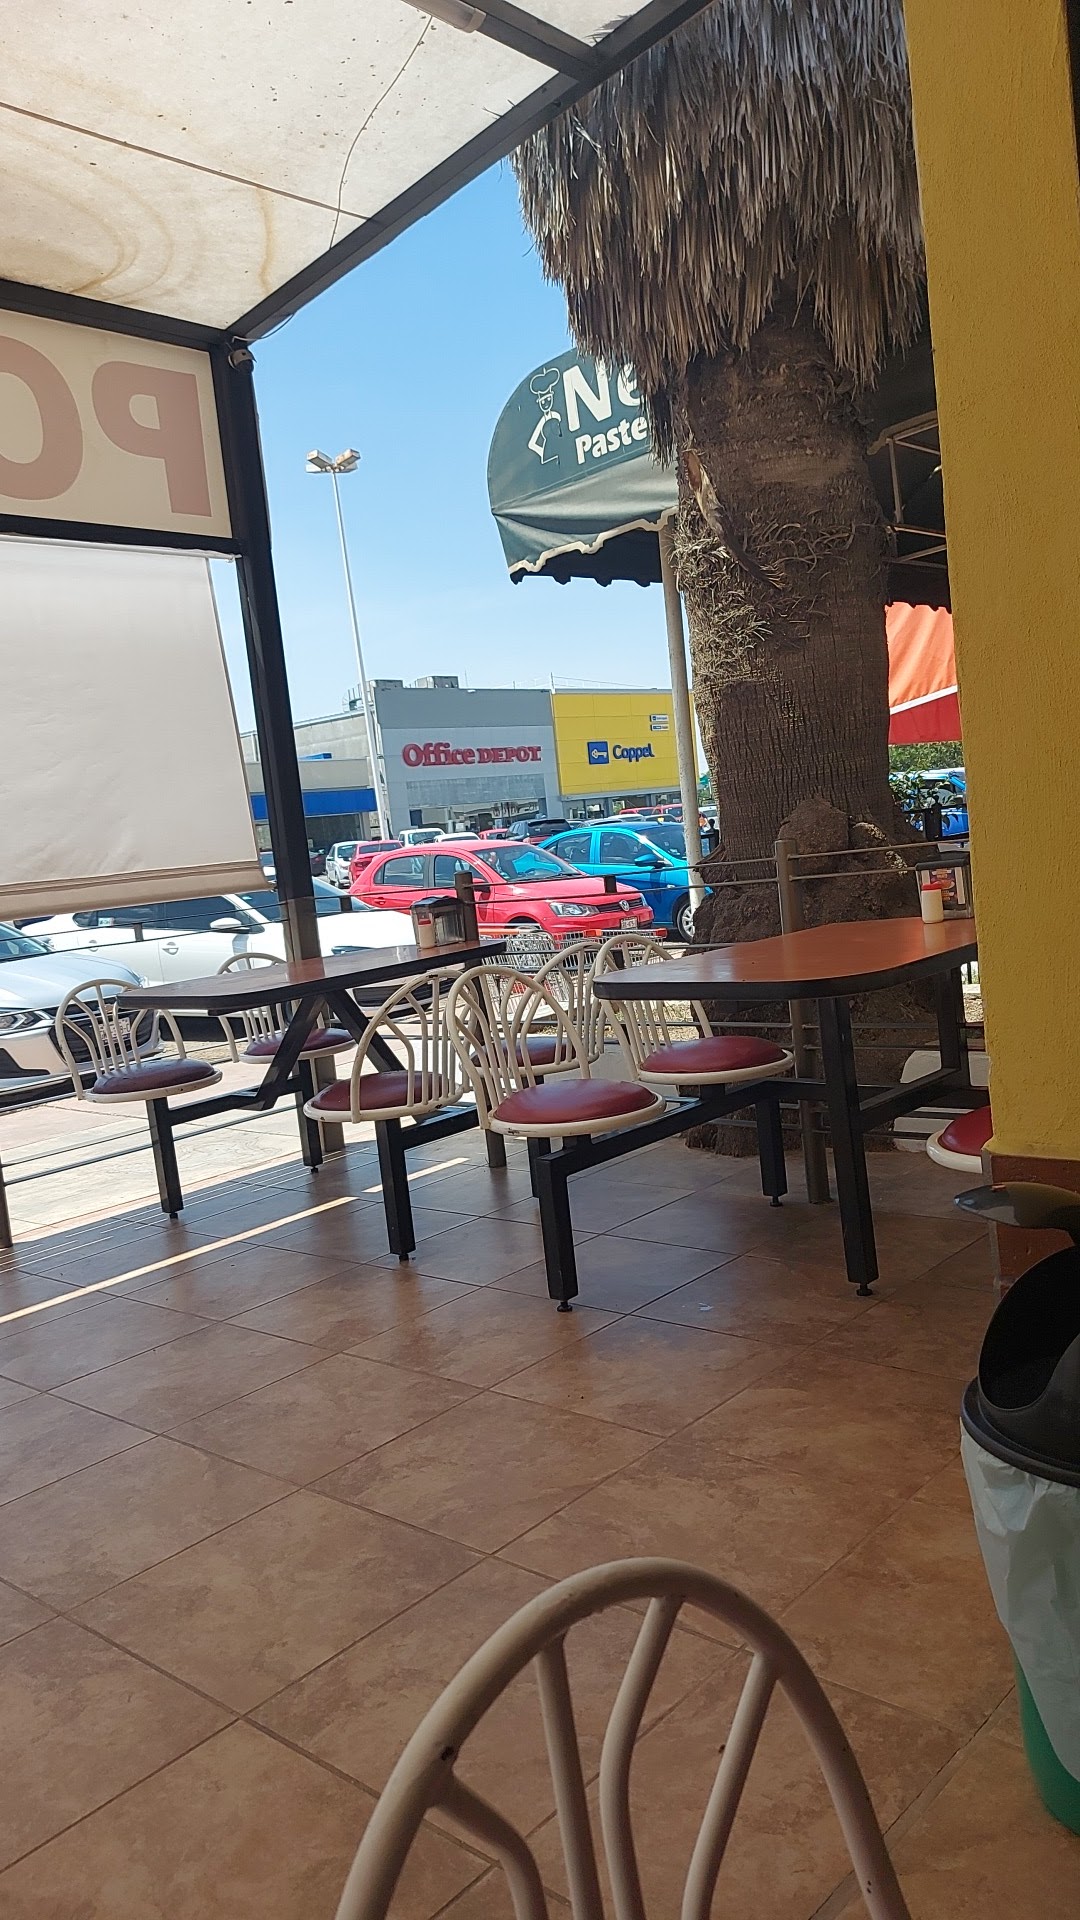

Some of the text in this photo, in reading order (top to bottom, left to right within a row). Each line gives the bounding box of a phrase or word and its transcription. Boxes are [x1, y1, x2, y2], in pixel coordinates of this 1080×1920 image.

[402, 742, 541, 767] Office DEPOT
[613, 743, 655, 762] Coppel
